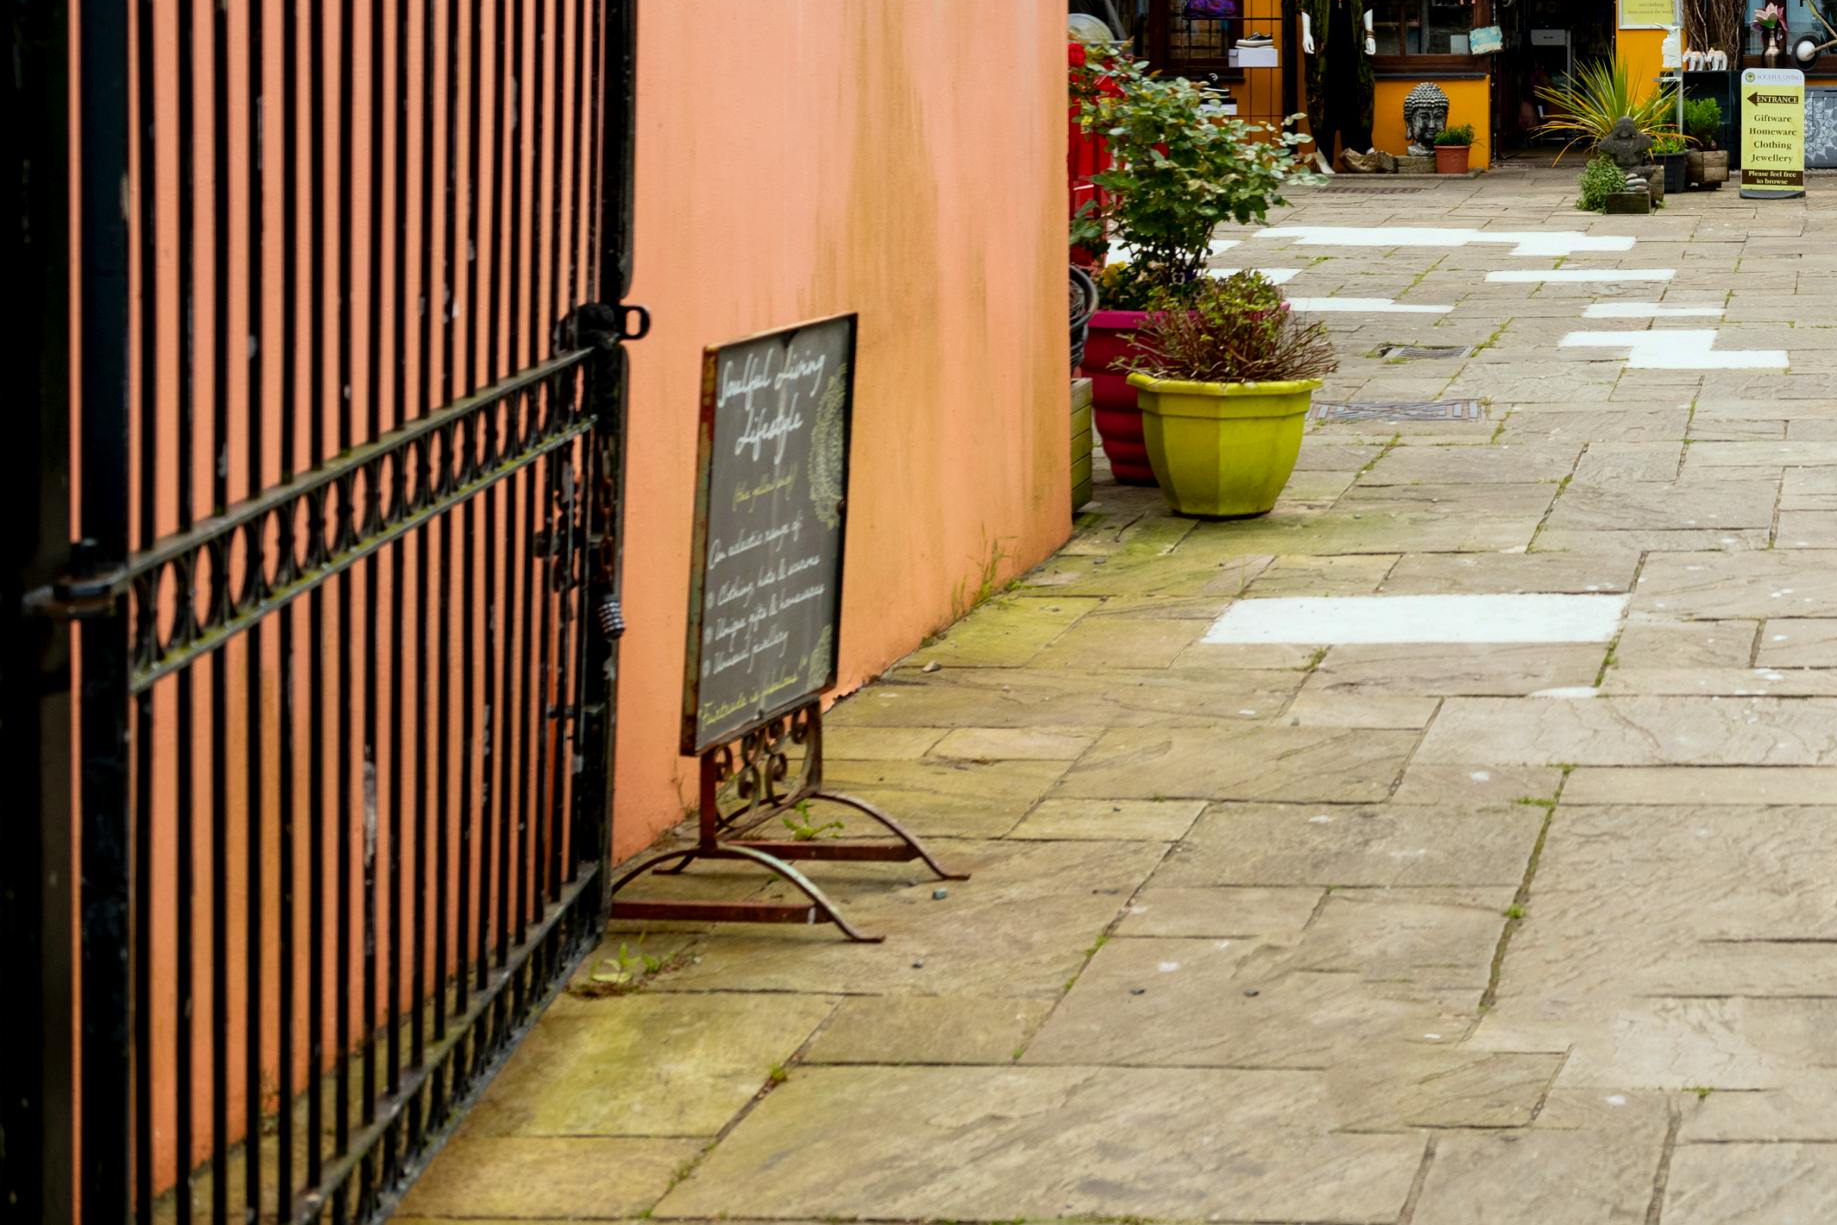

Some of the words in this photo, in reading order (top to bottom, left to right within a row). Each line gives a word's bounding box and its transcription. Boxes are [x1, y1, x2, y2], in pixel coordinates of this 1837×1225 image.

[1756, 95, 1798, 104] ENTRANCE
[1753, 113, 1792, 123] Giftware
[1749, 127, 1797, 137] Homeware
[1753, 140, 1792, 150] Clothing
[1750, 153, 1793, 164] Jewellery
[1770, 170, 1783, 178] feel
[717, 348, 774, 411] Soulful
[774, 343, 827, 398] Living
[734, 392, 804, 465] Lifestyle
